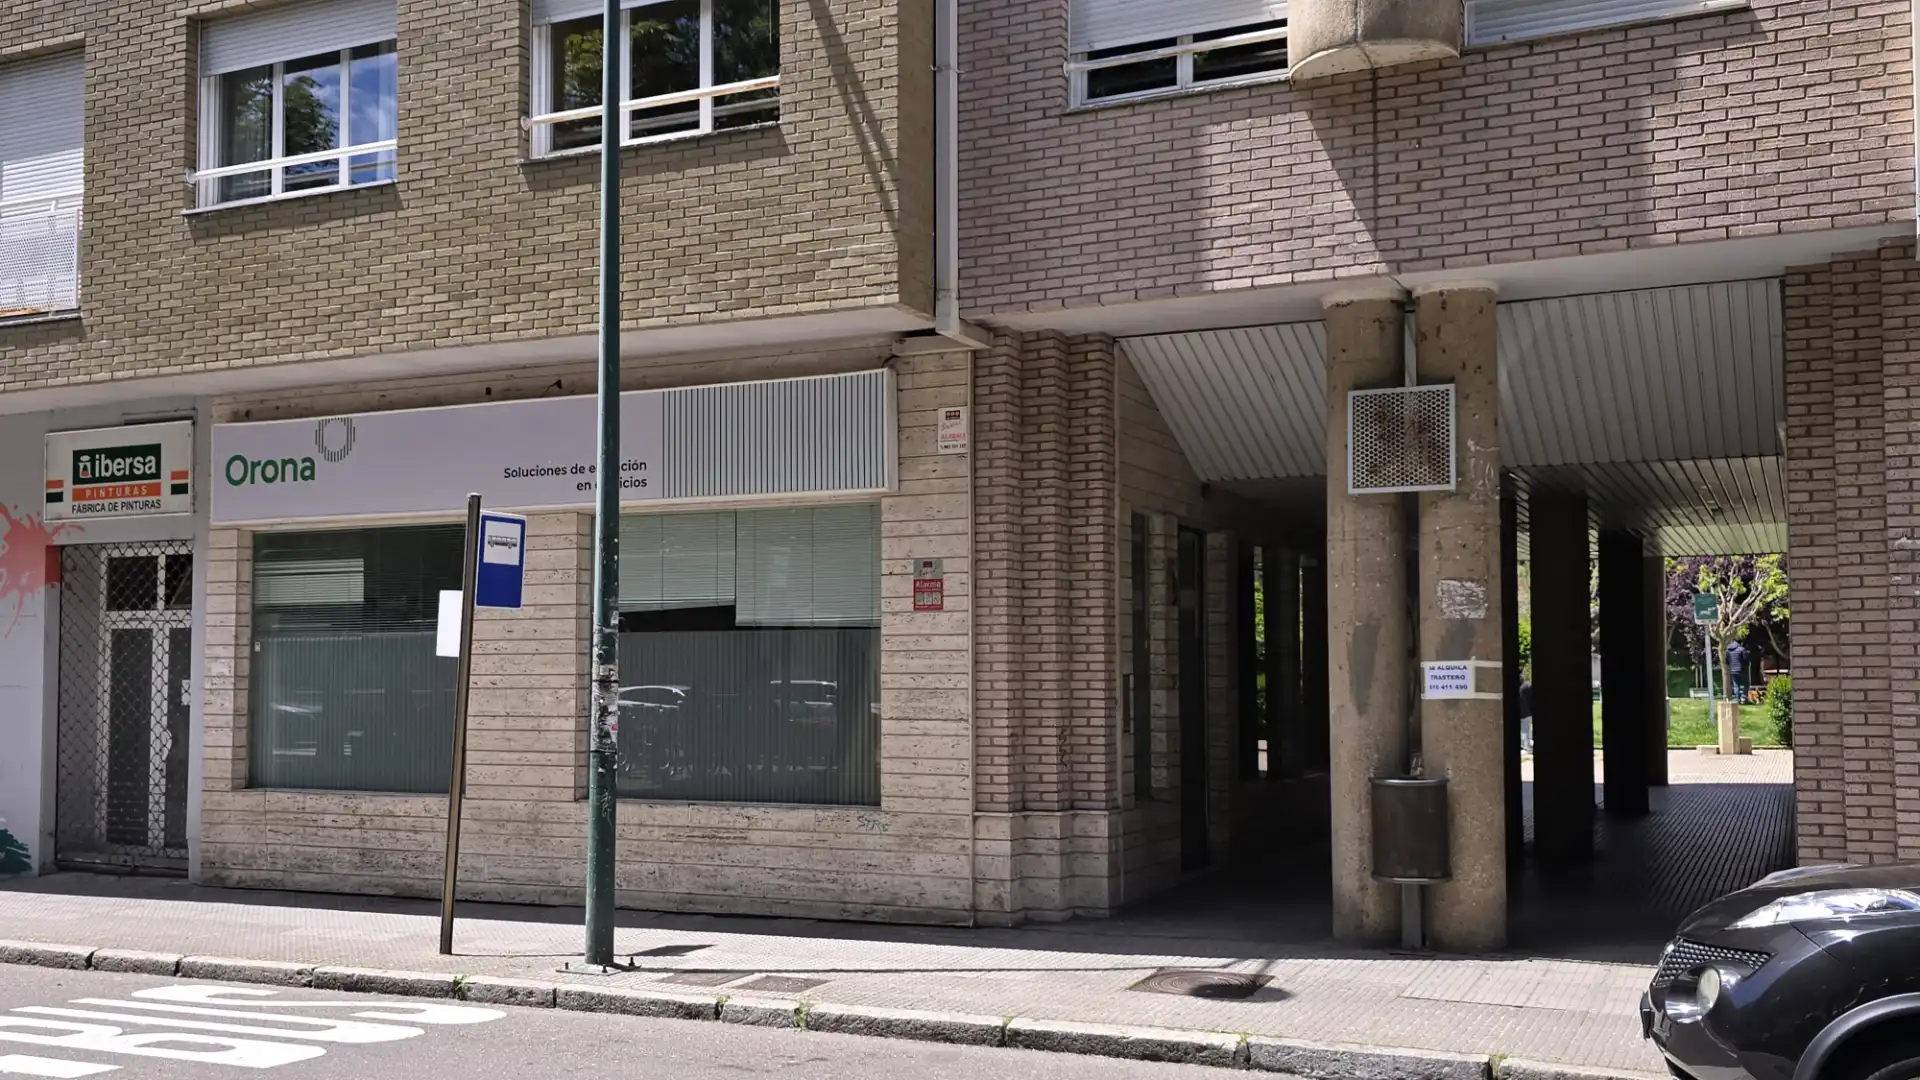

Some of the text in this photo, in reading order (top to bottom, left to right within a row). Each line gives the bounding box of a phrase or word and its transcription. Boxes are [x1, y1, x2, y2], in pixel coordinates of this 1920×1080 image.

[95, 453, 156, 478] ibersa
[225, 454, 316, 486] Orona
[504, 465, 567, 479] Soluciones
[570, 463, 585, 475] de
[85, 486, 148, 499] PINTURAS
[576, 482, 592, 491] en
[107, 502, 119, 512] DE
[120, 499, 162, 511] PINTURAS
